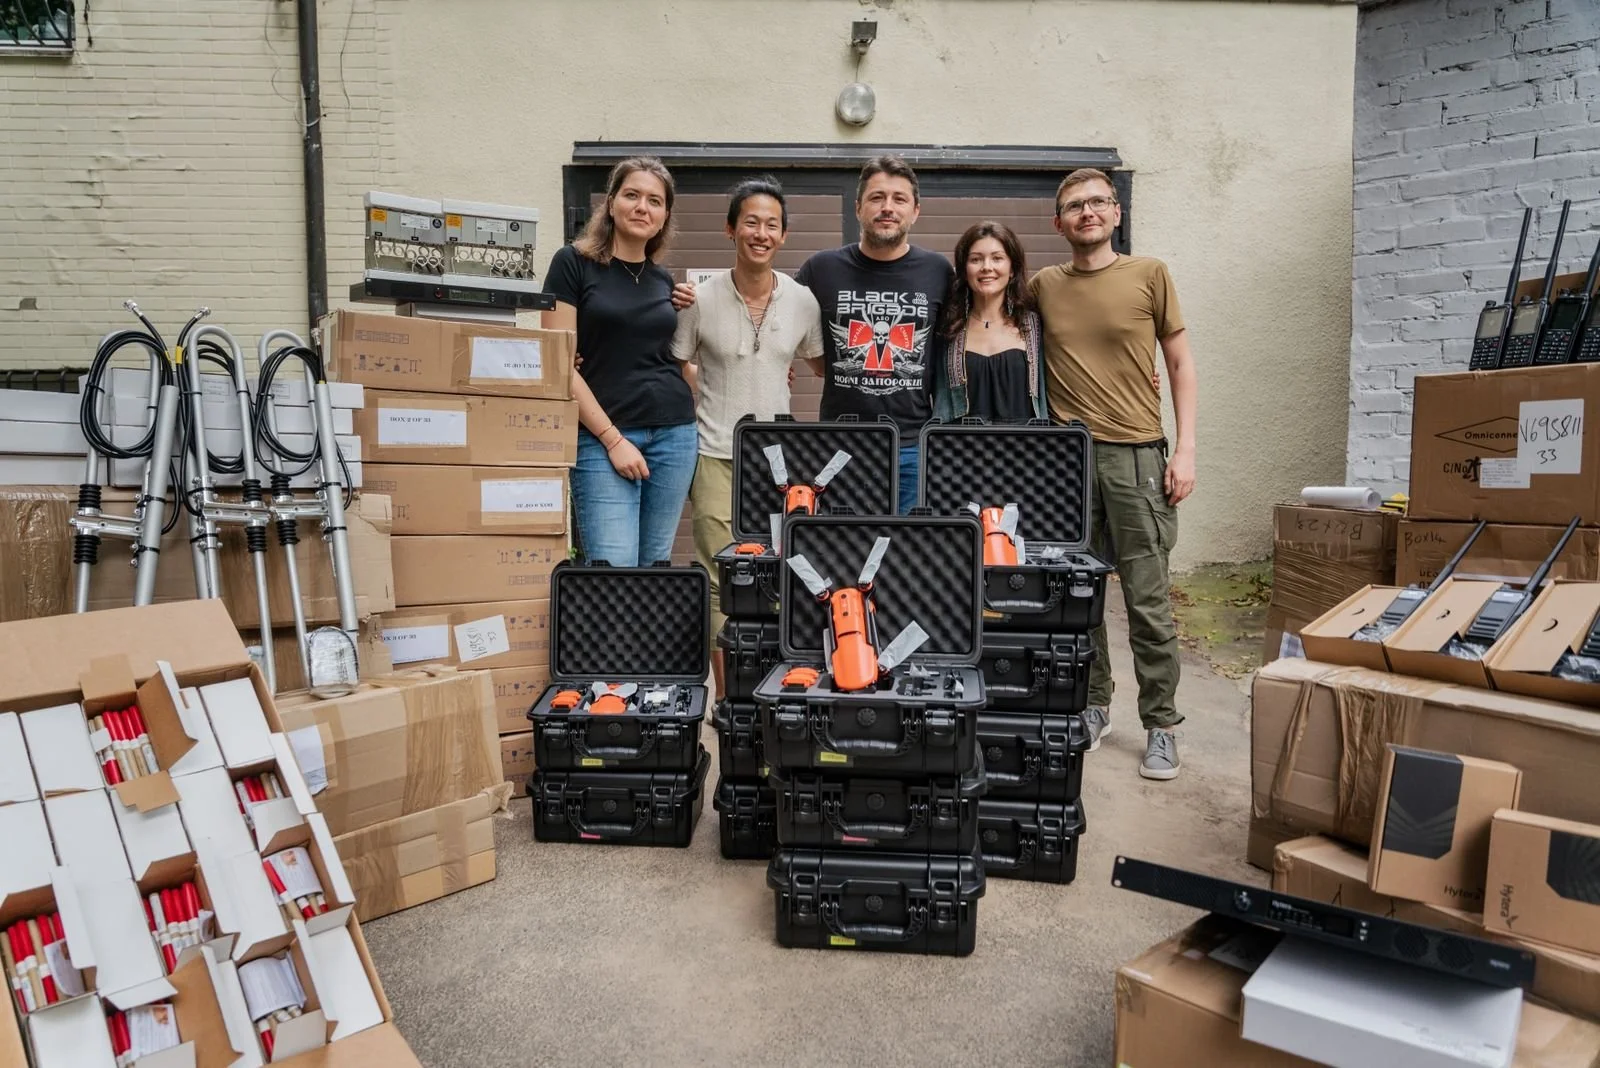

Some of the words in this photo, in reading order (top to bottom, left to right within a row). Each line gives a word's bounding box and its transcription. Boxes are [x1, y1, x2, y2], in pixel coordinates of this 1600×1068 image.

[838, 291, 909, 303] BLACK
[837, 303, 928, 317] BRIGADE
[1536, 448, 1557, 465] 33
[1500, 884, 1514, 918] Hytera
